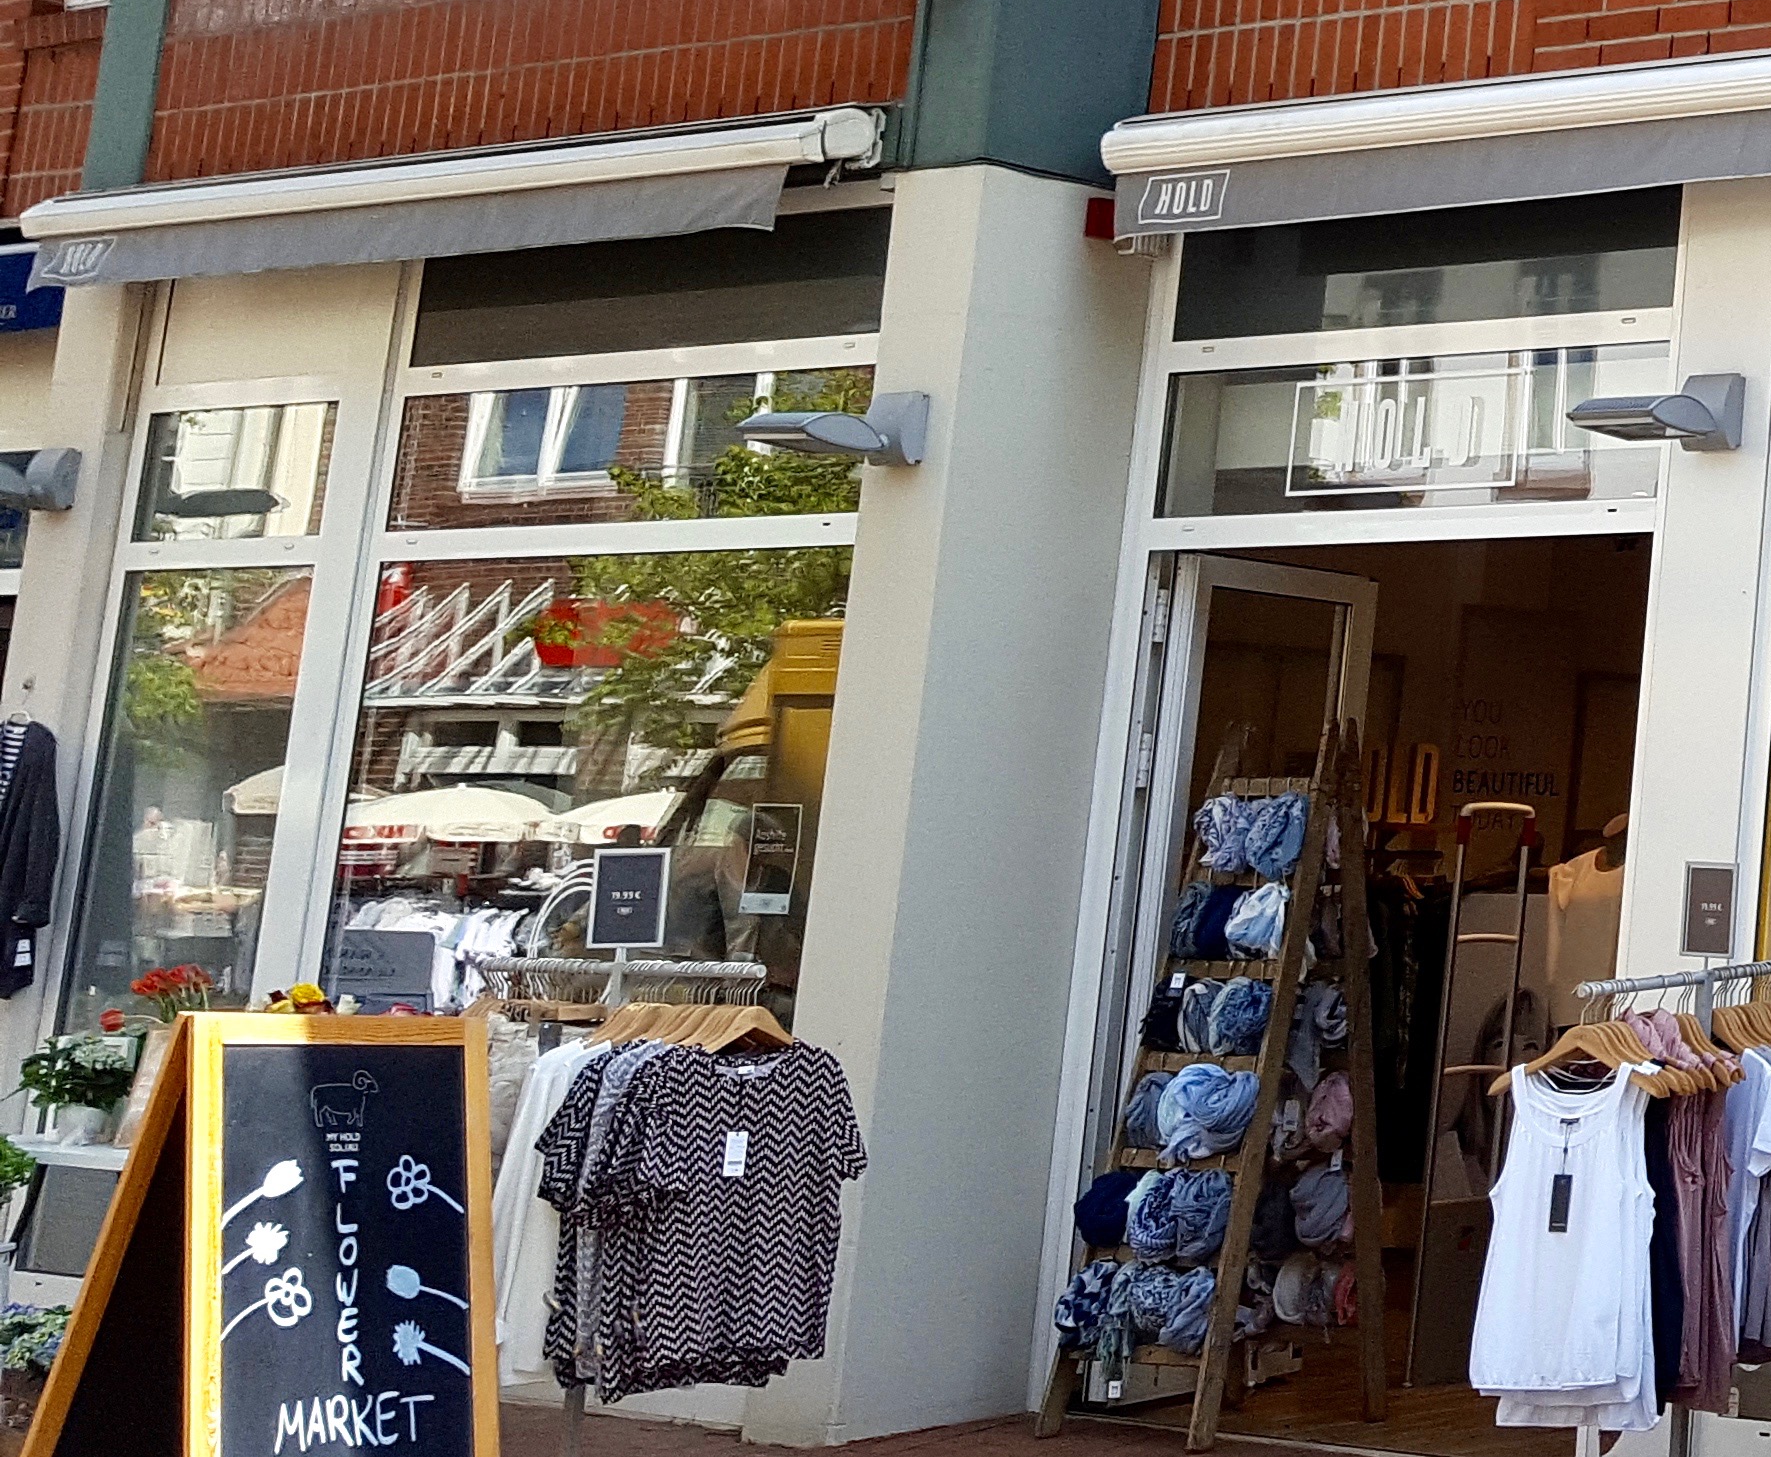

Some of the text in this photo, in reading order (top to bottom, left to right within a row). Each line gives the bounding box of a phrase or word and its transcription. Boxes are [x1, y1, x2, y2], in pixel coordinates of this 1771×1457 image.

[1153, 178, 1213, 215] HOLD
[1452, 769, 1560, 797] BEAUTIFUL
[1452, 804, 1518, 831] TDAY
[330, 1159, 364, 1386] FLOWER
[274, 1391, 435, 1455] MARKET
